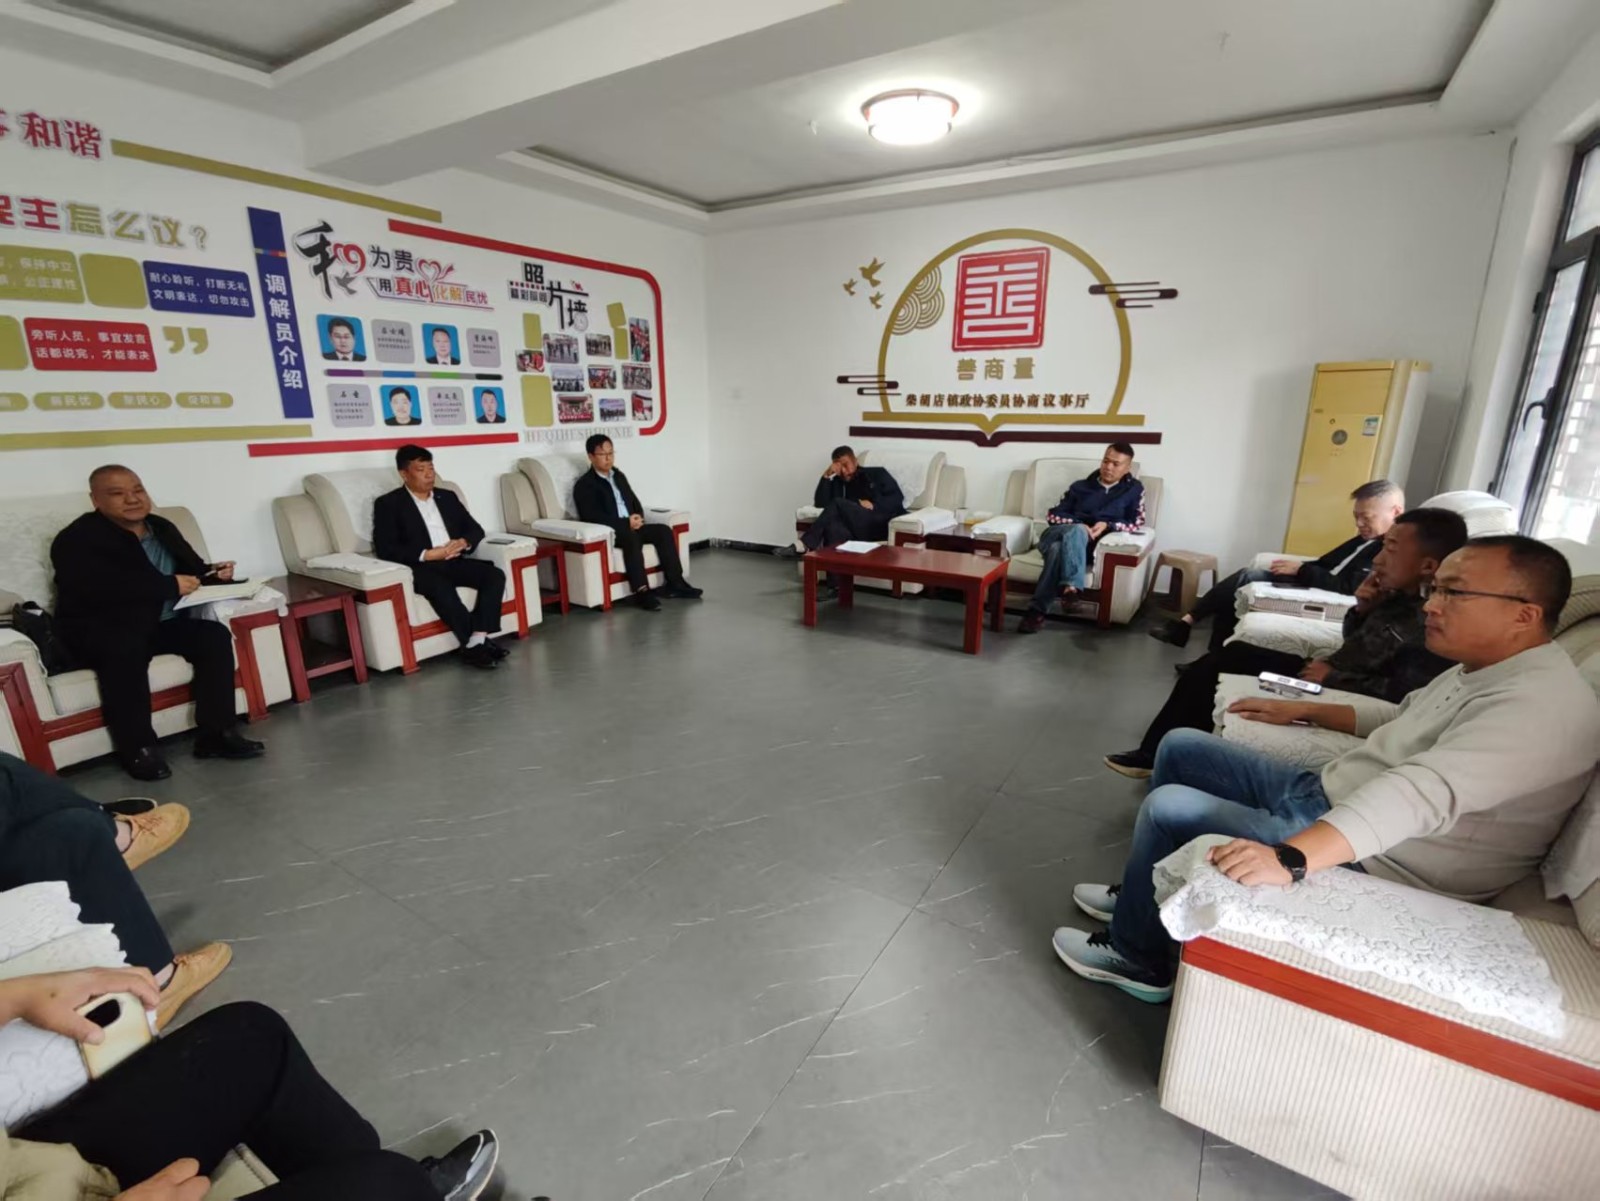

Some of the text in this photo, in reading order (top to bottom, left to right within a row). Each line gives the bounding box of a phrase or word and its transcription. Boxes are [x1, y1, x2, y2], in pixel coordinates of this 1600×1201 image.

[380, 277, 489, 304] 用真心化解民忧
[265, 273, 304, 390] 调解员介绍
[957, 357, 1035, 380] 善商量
[905, 393, 1091, 409] 柴胡店镇政协委员协商议事厅
